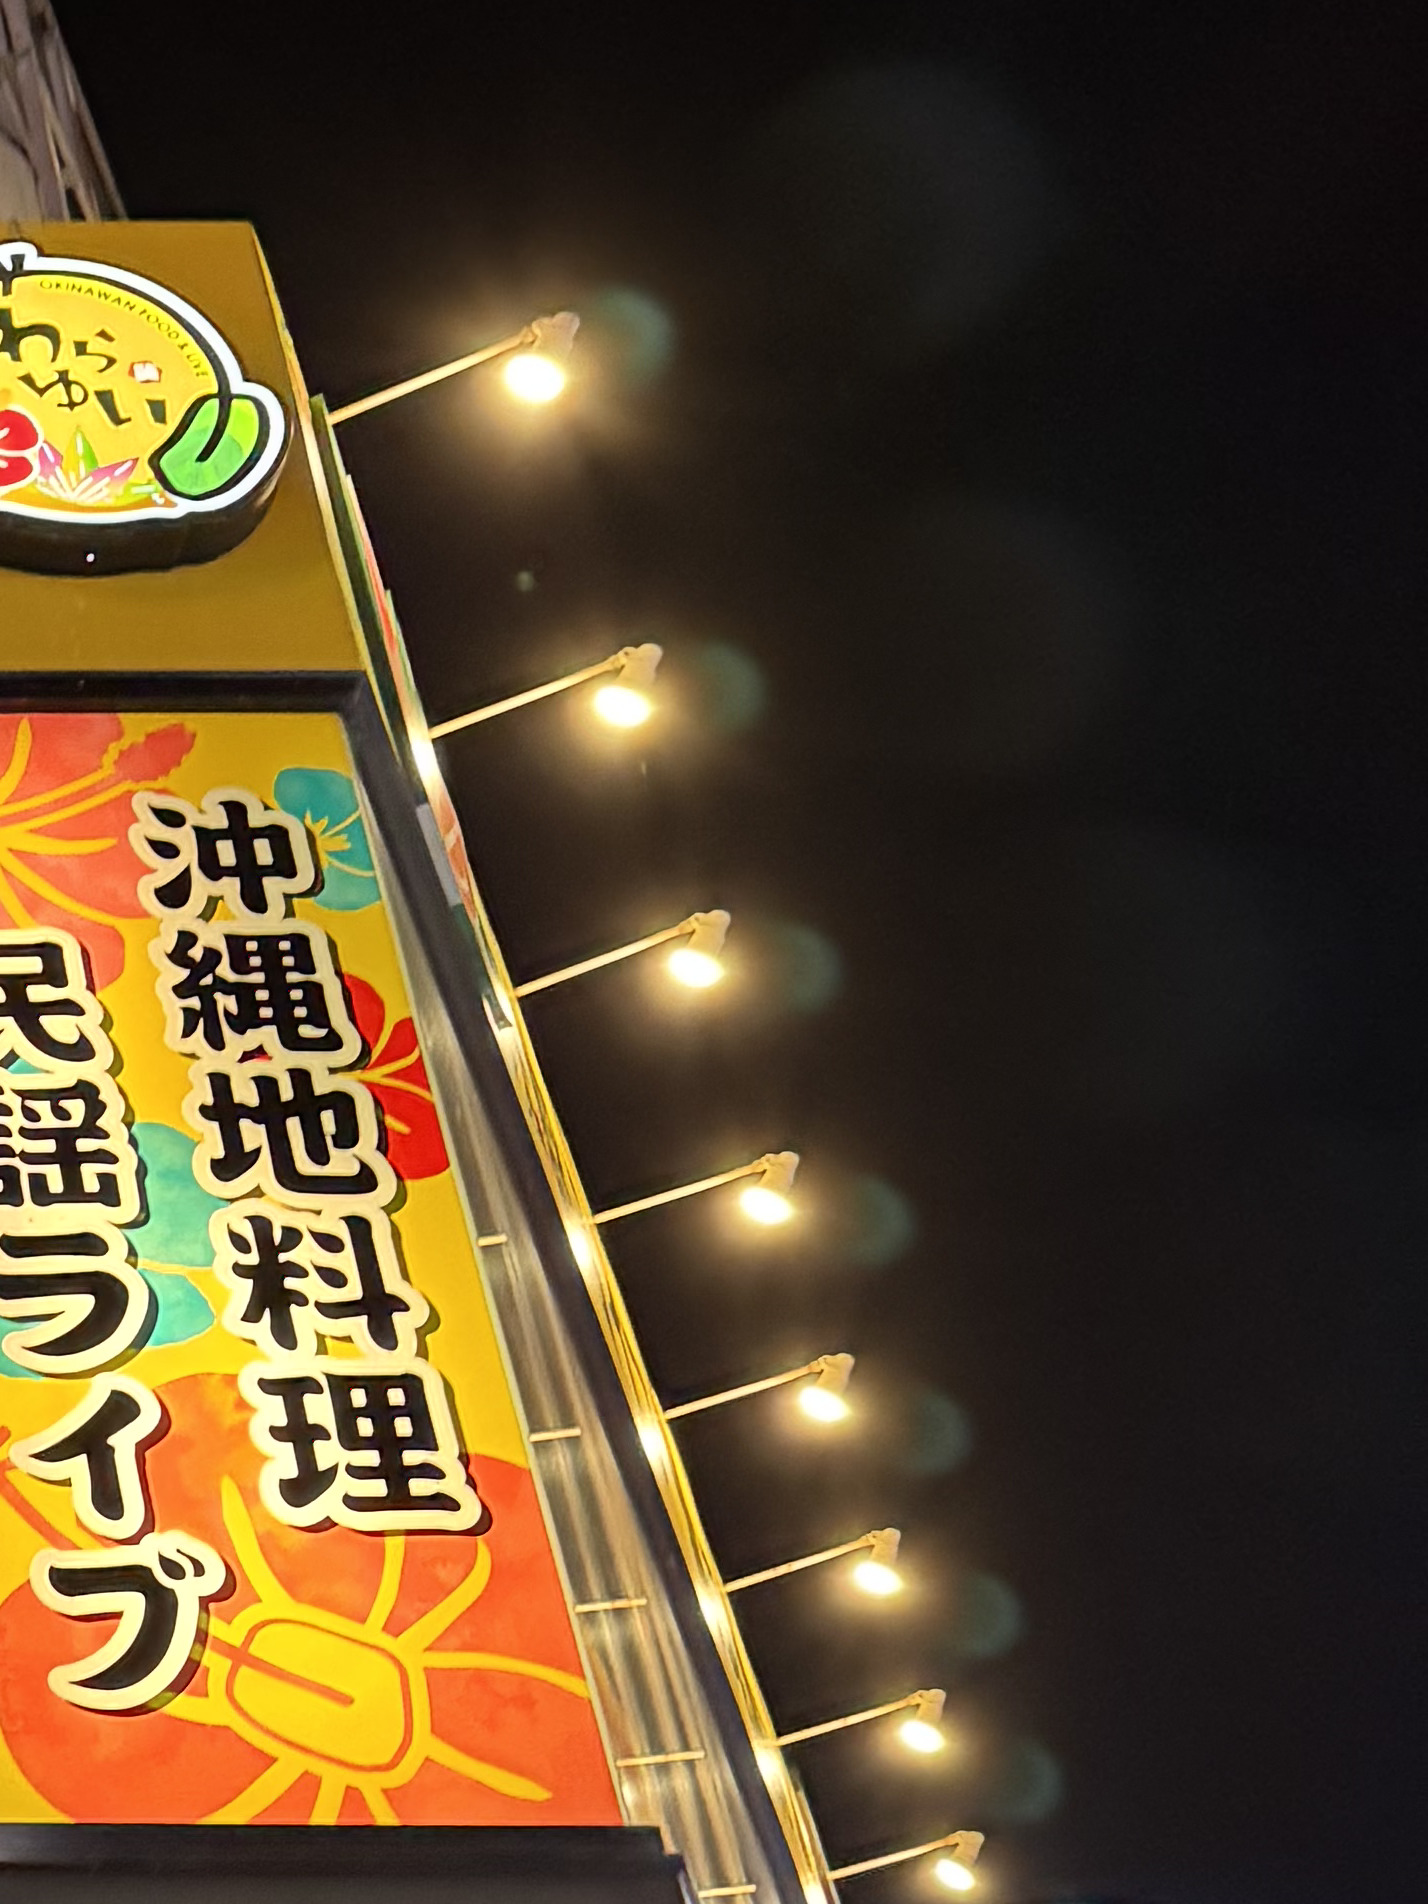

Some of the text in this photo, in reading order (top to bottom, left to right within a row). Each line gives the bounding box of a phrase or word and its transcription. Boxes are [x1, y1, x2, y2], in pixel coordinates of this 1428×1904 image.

[40, 279, 137, 313] OKINAWAN
[152, 797, 462, 1516] 沖縄地料理
